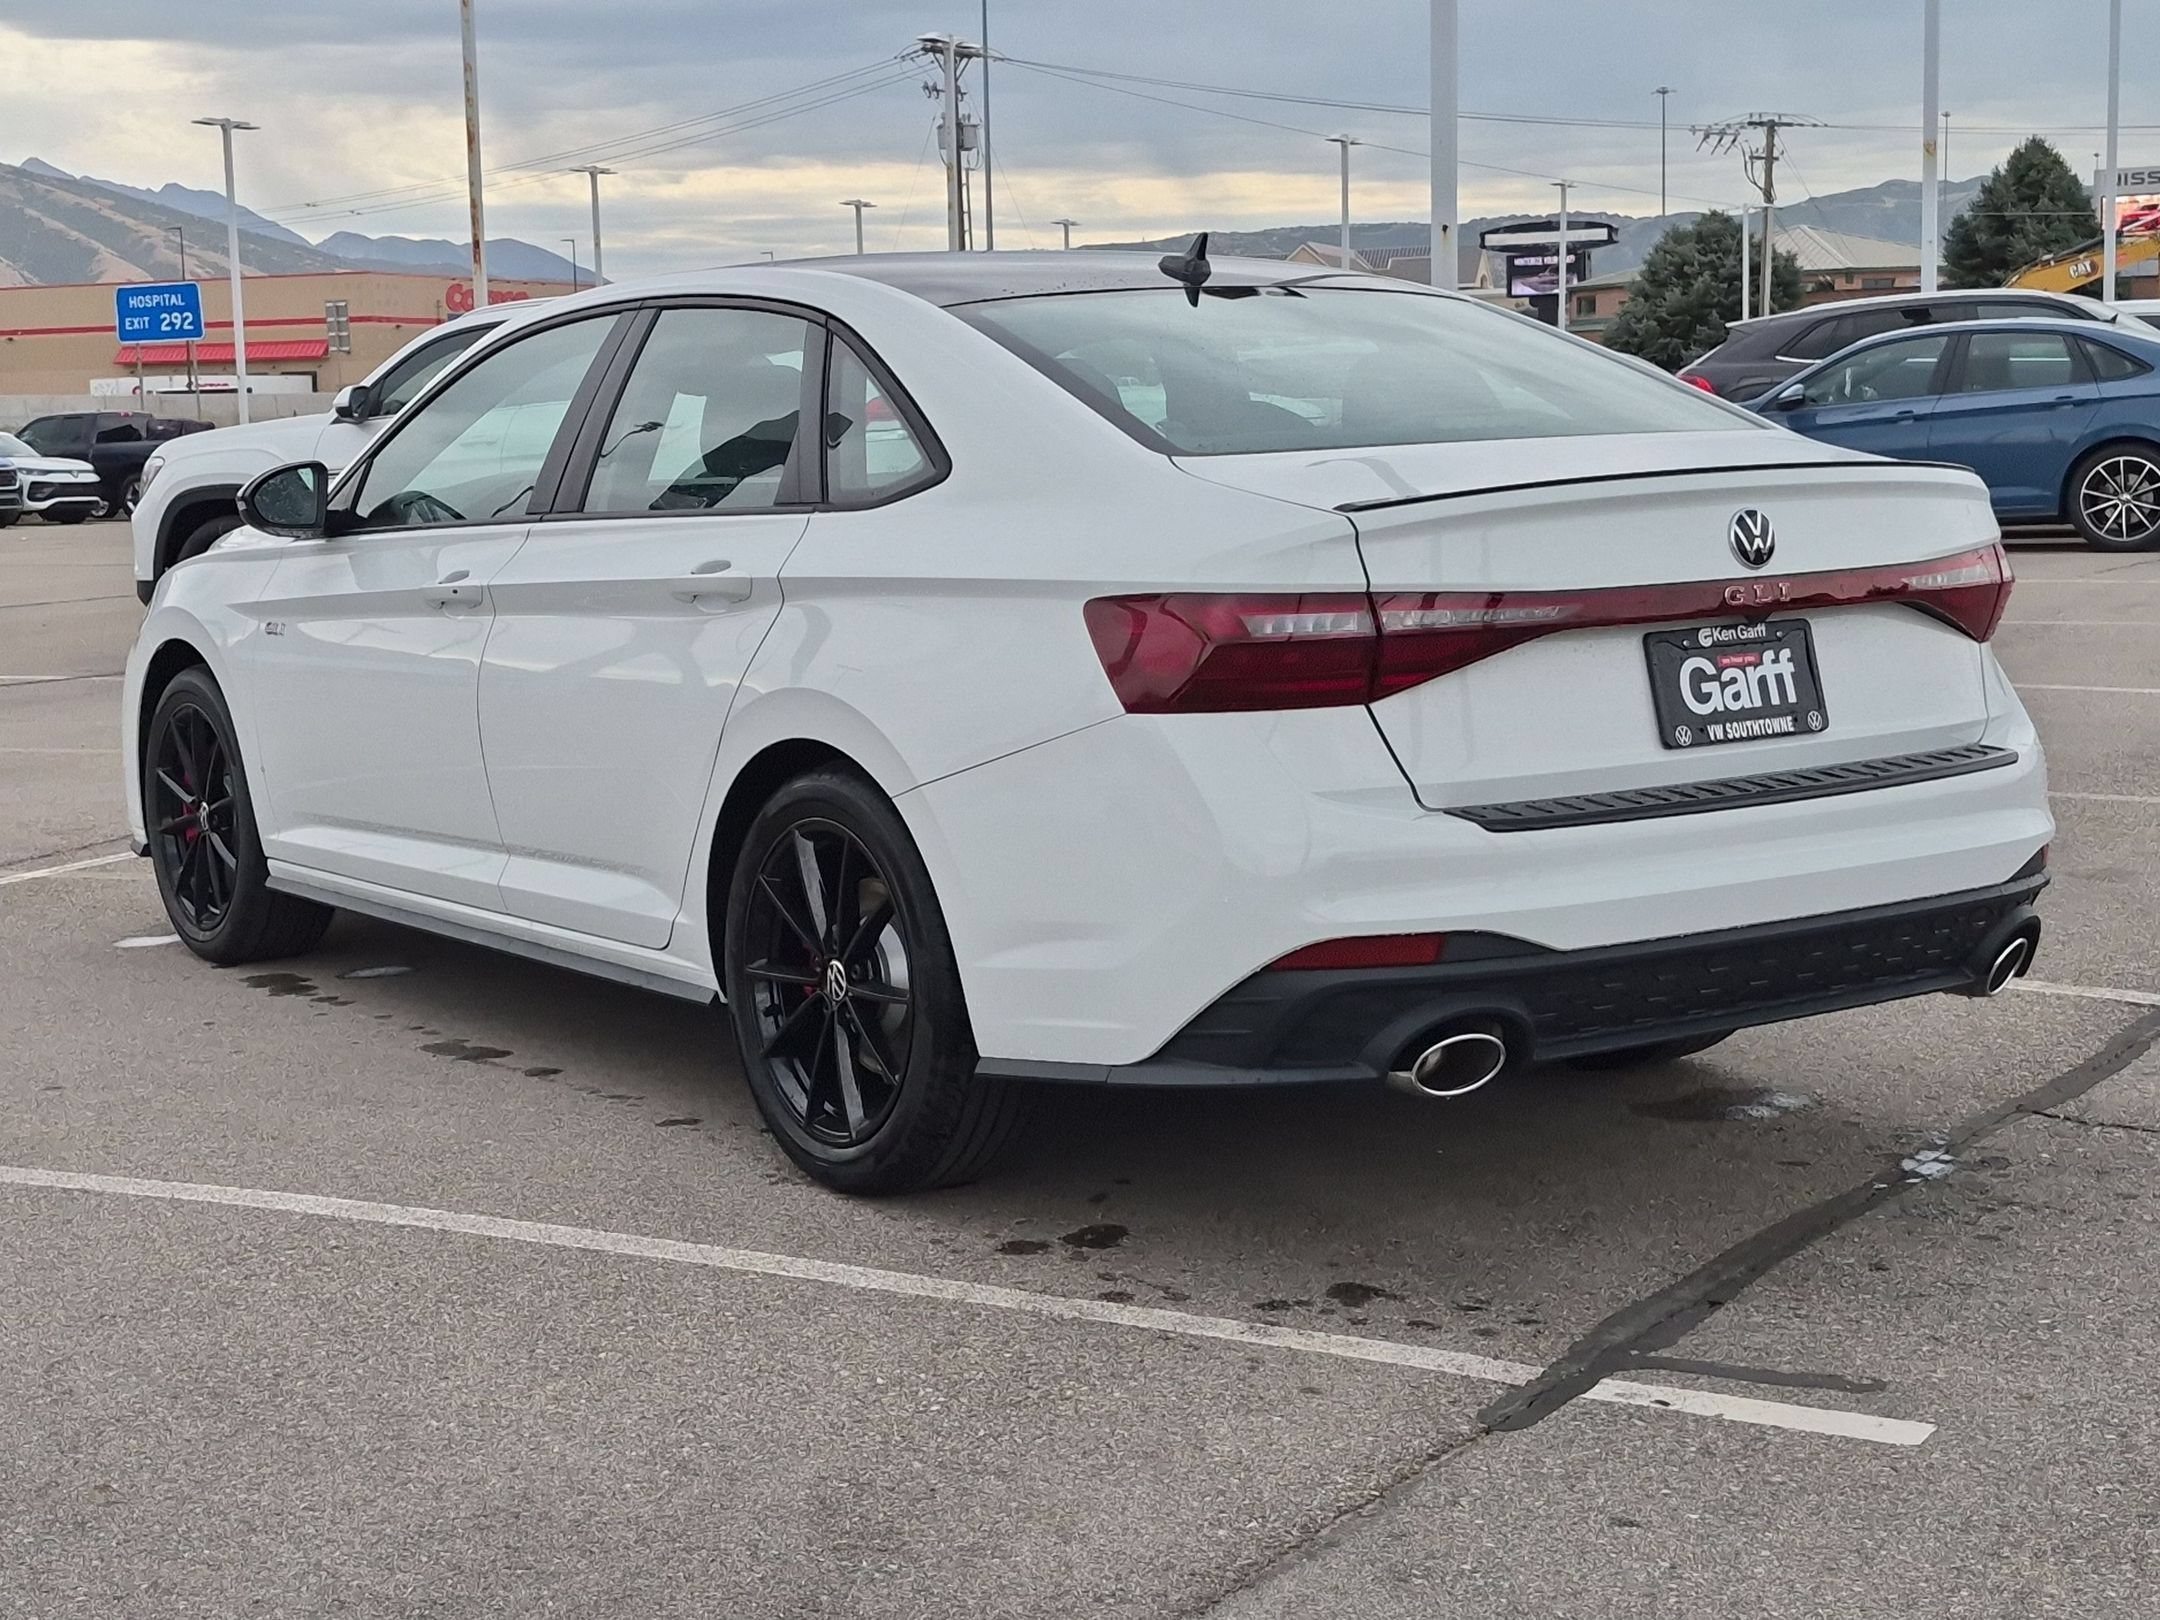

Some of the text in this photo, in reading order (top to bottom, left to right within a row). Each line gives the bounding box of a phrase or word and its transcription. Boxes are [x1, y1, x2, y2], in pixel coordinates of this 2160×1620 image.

[2069, 260, 2092, 279] CAT
[128, 293, 186, 309] HOSPITAL
[125, 311, 194, 331] EXIT 292
[1724, 581, 1791, 606] GLI
[1712, 626, 1738, 642] Ken
[1737, 622, 1766, 640] Garff
[1679, 648, 1798, 715] Garff
[1706, 716, 1795, 741] VW SOUTHTOWNE
